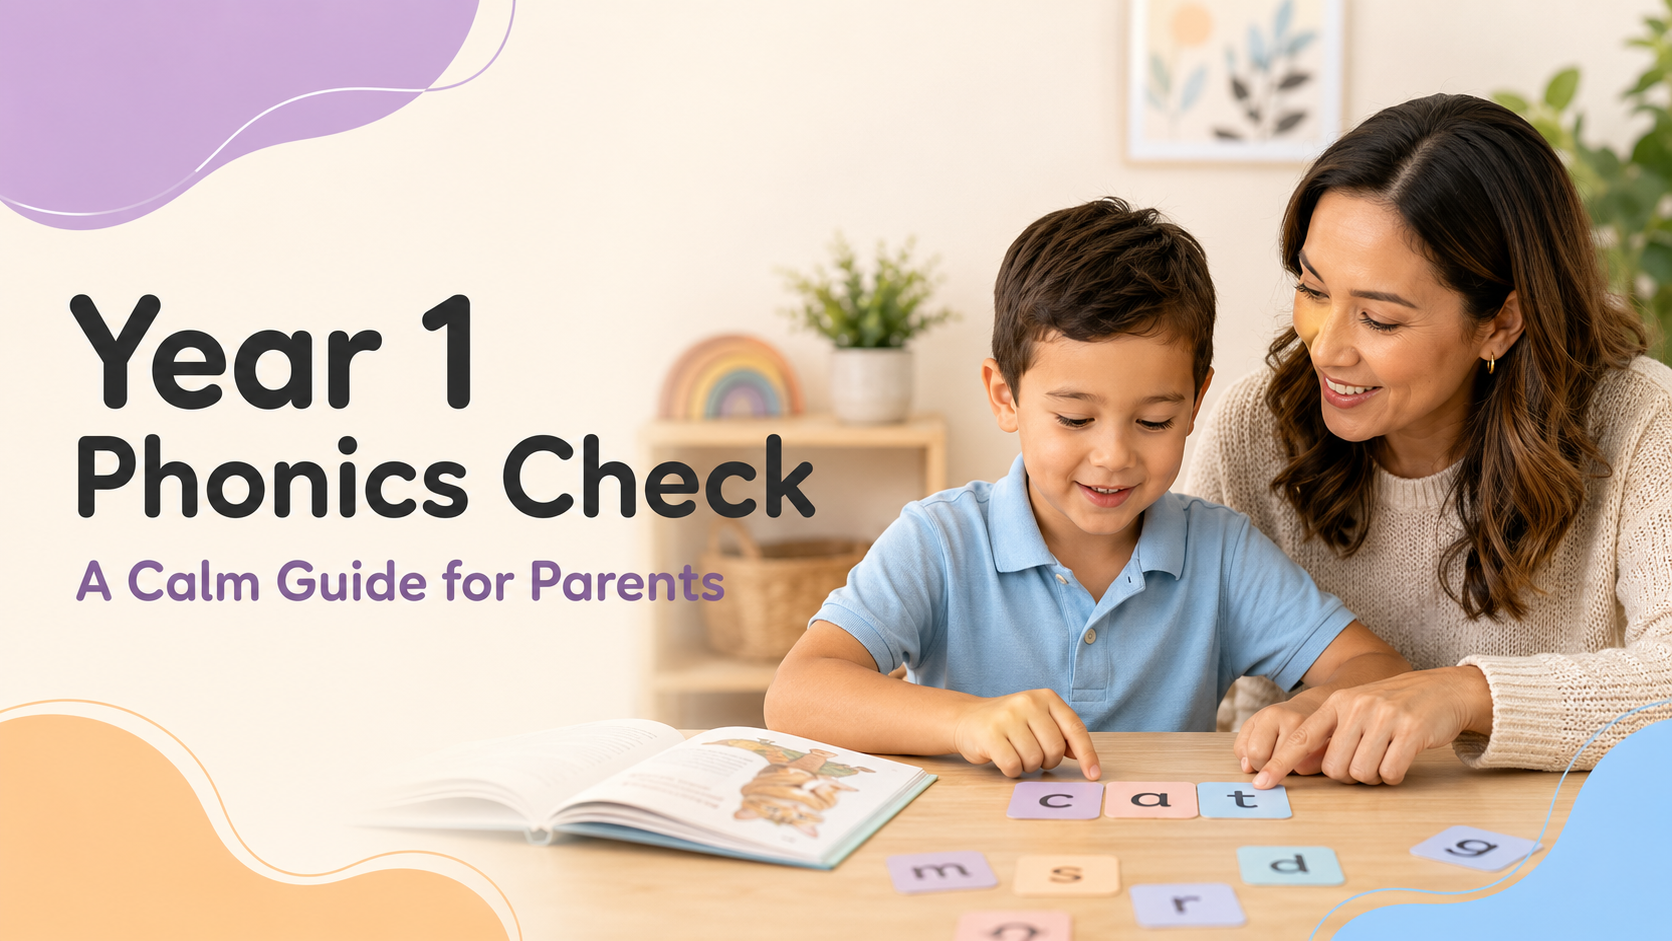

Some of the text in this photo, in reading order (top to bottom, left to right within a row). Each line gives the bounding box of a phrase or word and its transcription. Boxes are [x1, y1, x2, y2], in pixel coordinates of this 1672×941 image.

[1445, 837, 1499, 858] g
[911, 863, 969, 880] m
[1270, 853, 1308, 874] d
[1051, 866, 1084, 881] s
[1172, 894, 1201, 913] r
